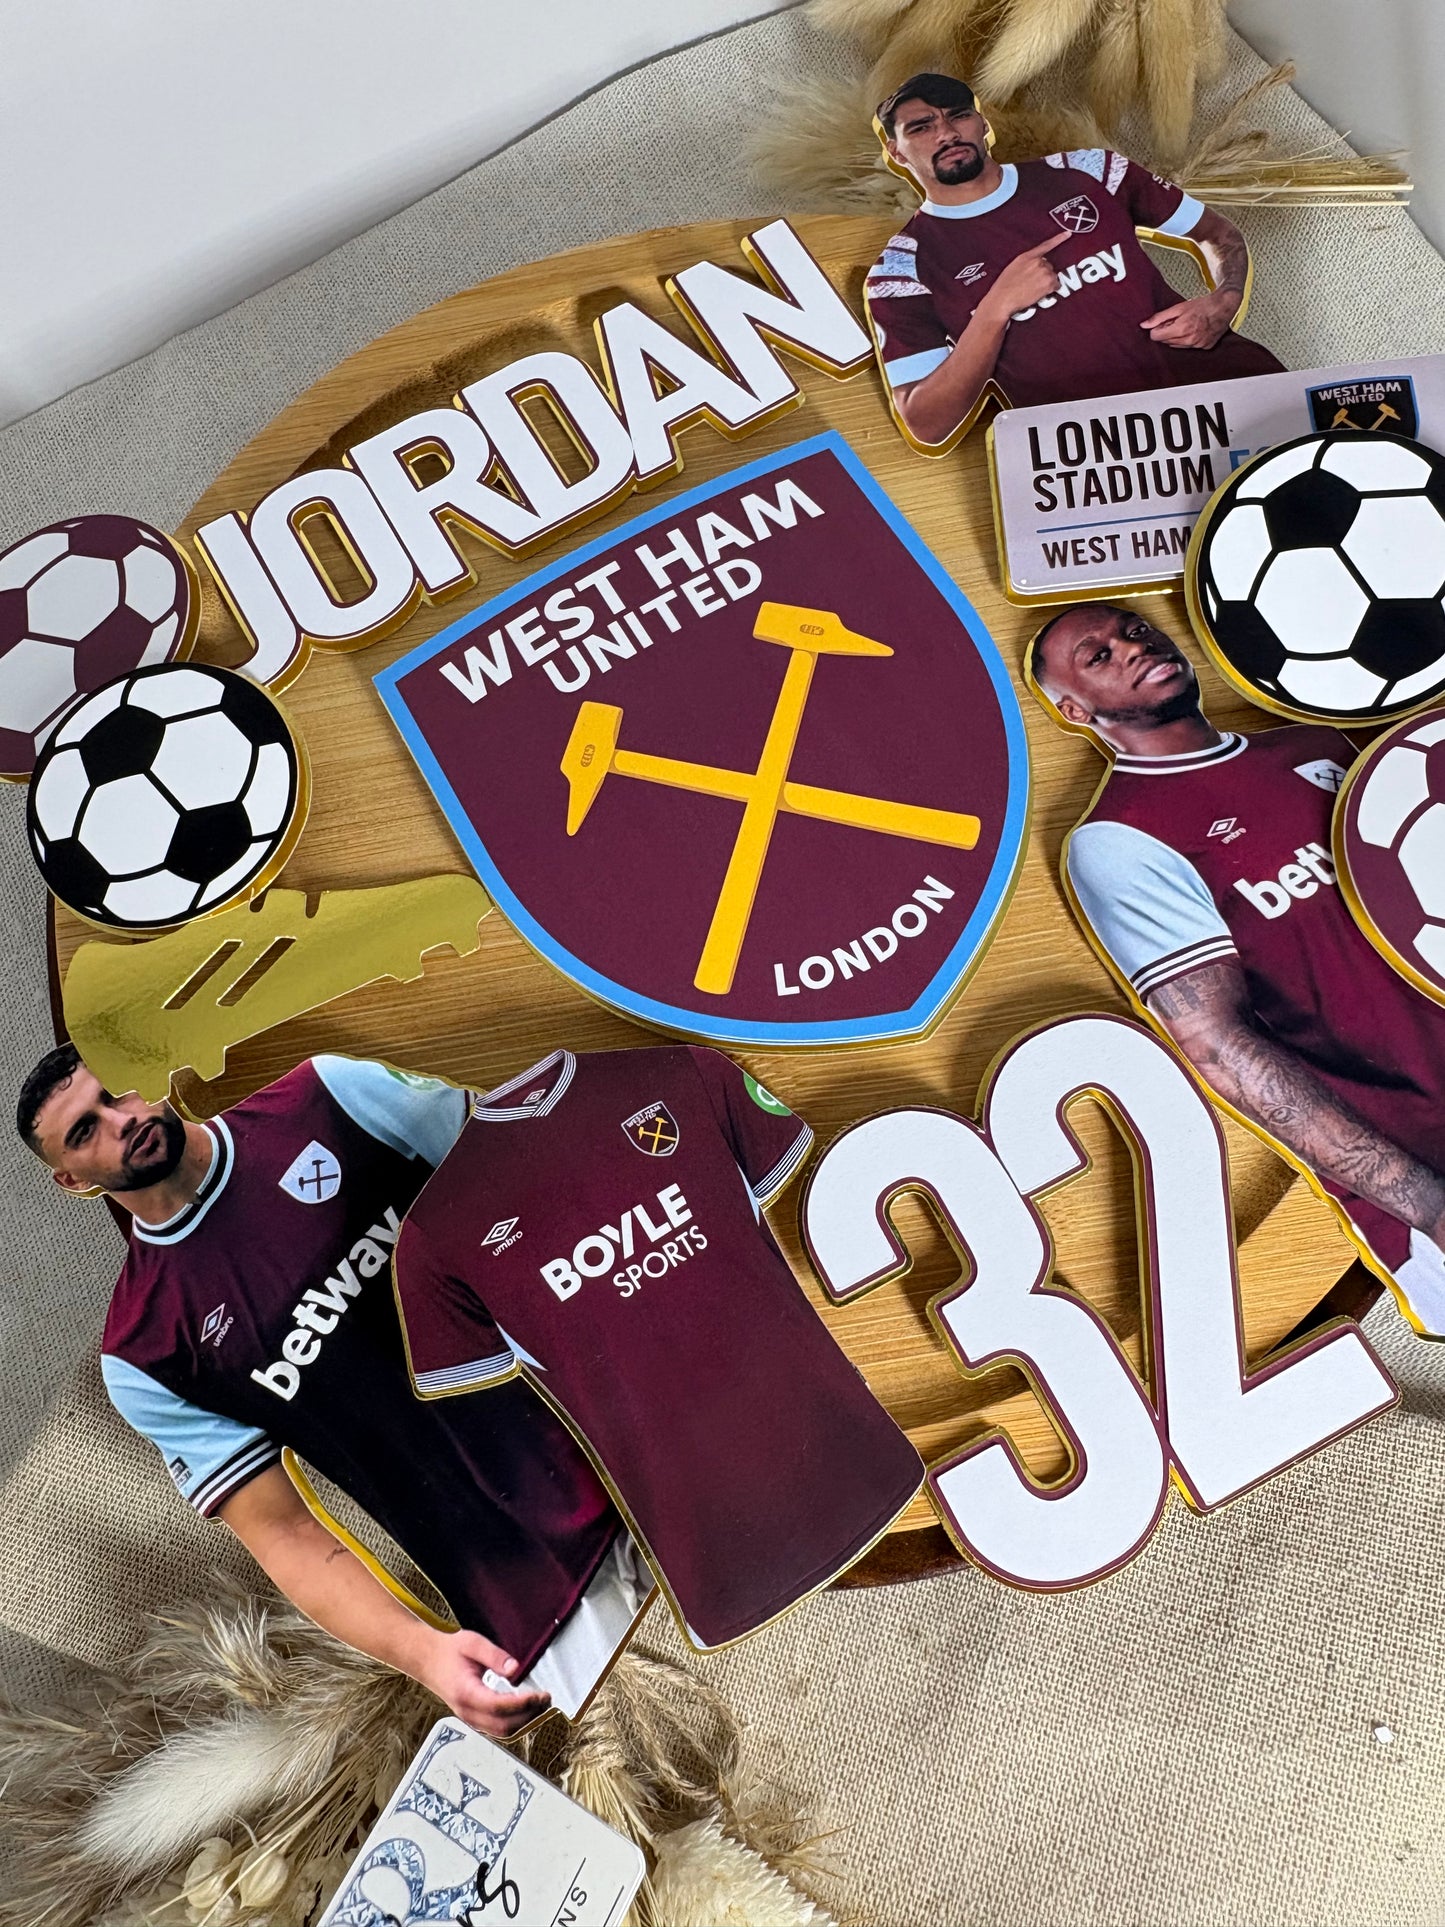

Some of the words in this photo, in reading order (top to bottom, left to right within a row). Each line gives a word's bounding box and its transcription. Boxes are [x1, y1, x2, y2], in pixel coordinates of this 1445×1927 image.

[1318, 385, 1357, 401] WEST
[1361, 381, 1402, 394] HAM
[1337, 392, 1385, 407] UNITED
[197, 219, 873, 686] JORDAN
[1028, 401, 1230, 471] LONDON
[1034, 454, 1216, 512] STADIUM
[1042, 534, 1120, 569] WEST
[439, 561, 627, 704] WEST
[635, 479, 826, 590] HAM
[542, 558, 762, 693] UNITED
[773, 874, 955, 997] LONDON
[492, 1230, 523, 1257] umbro
[540, 1182, 693, 1302] BOYLE
[612, 1225, 708, 1298] SPORTS
[213, 1316, 234, 1347] umbro
[804, 1016, 1398, 1584] 32
